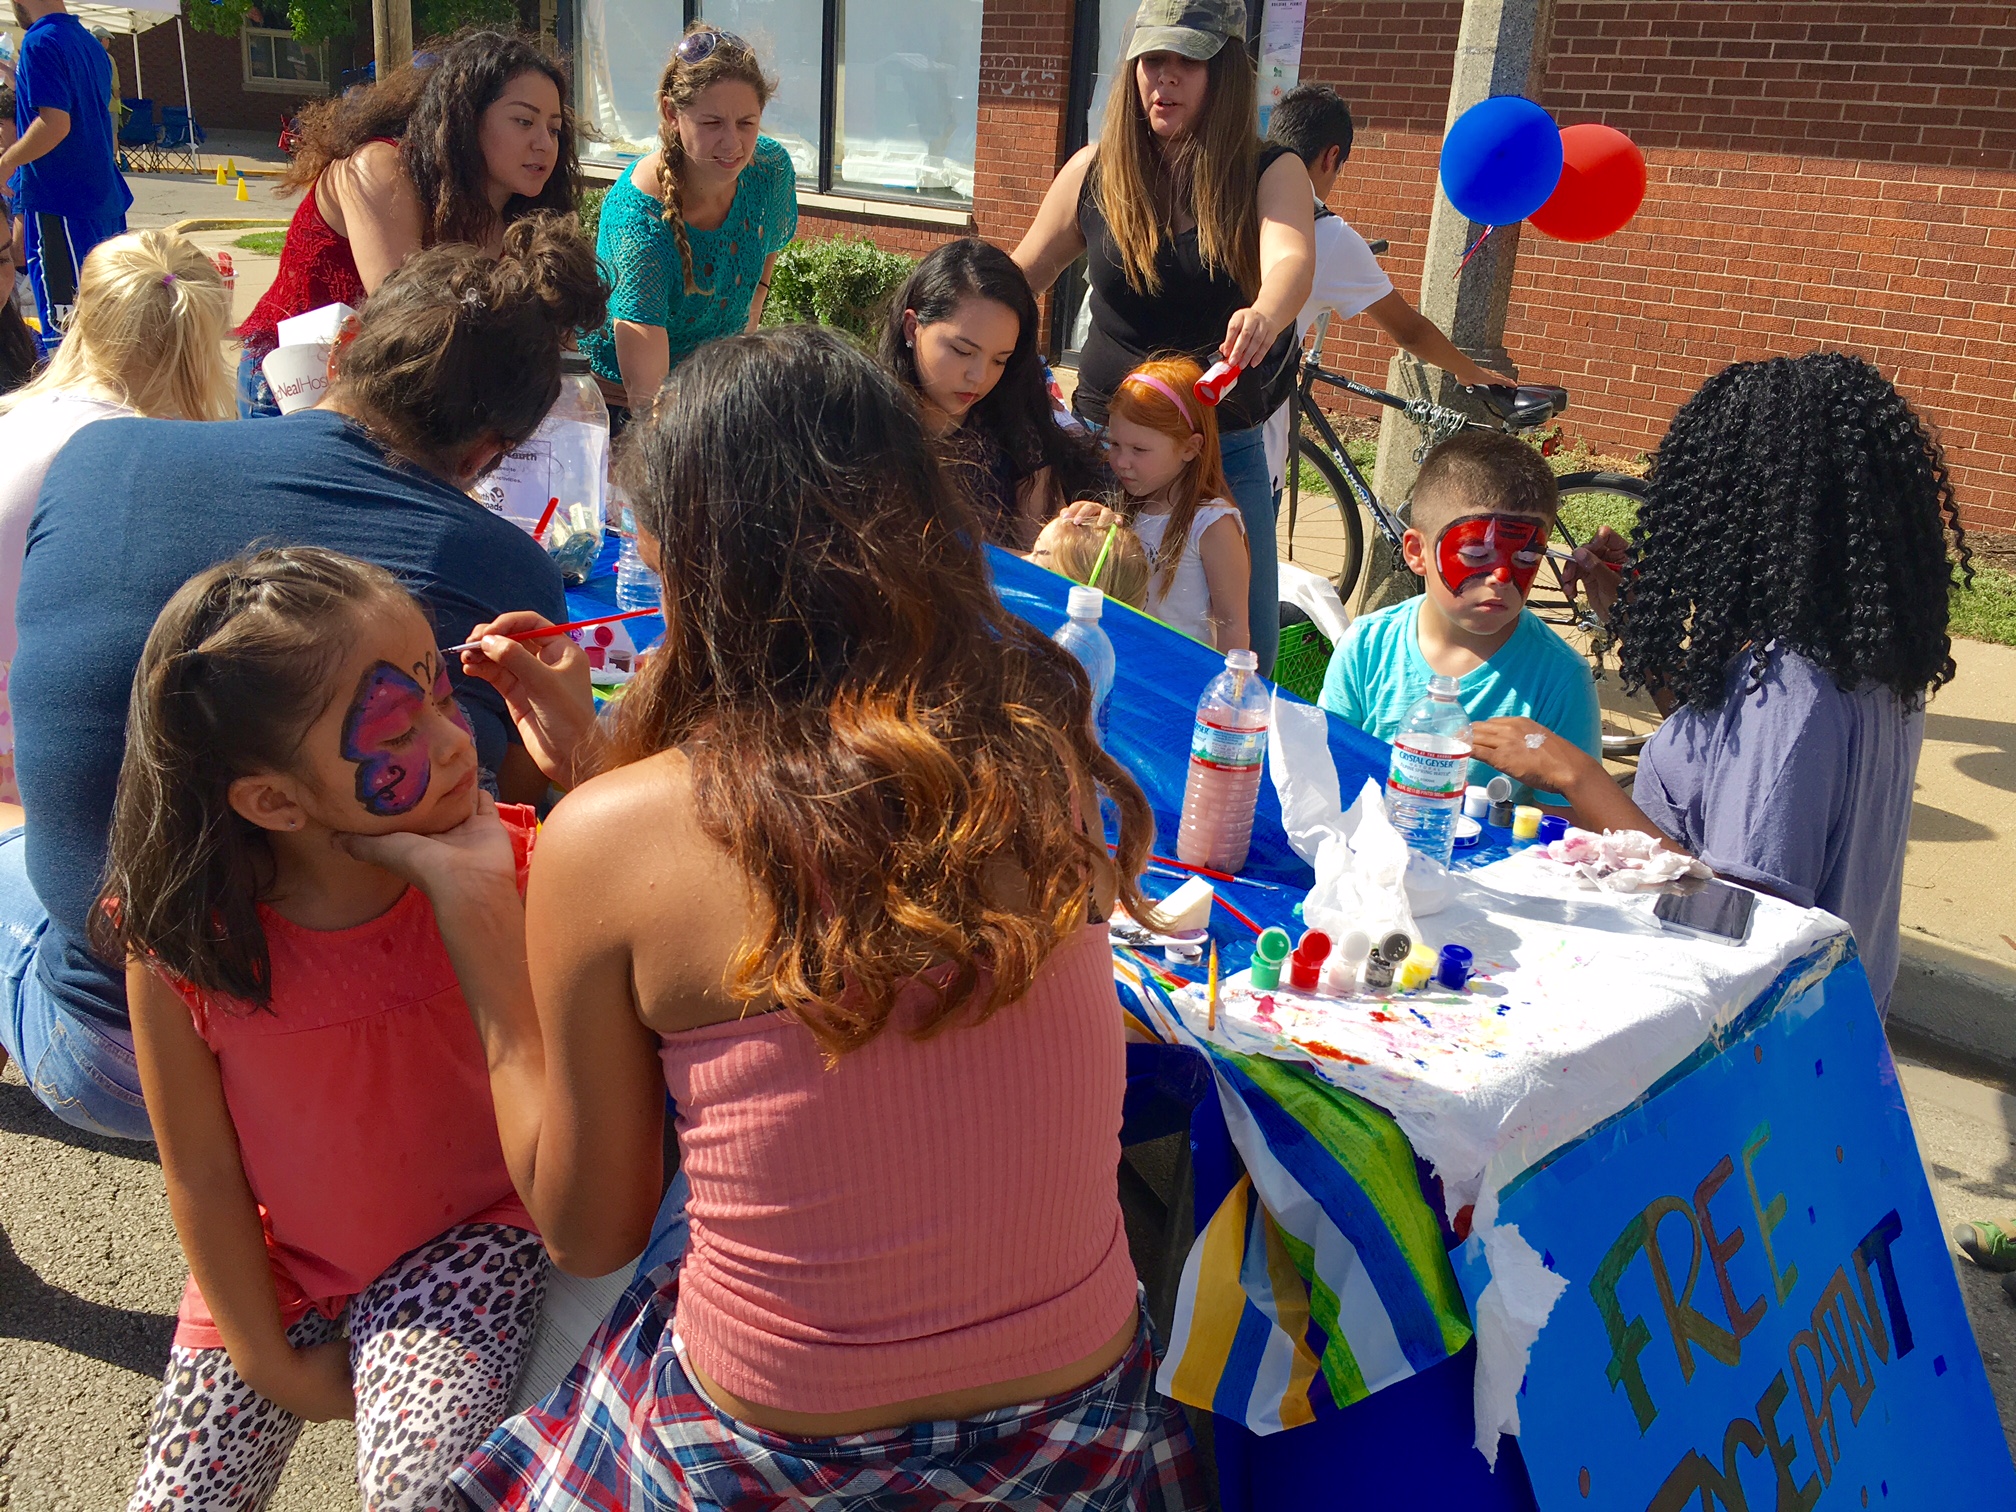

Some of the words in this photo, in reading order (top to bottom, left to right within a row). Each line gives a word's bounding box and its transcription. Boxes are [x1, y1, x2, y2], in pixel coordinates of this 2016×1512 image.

[1332, 448, 1395, 542] DIAMONDBACK
[1399, 751, 1424, 765] CRYSTAL
[1425, 758, 1453, 768] GEYSER
[1588, 1118, 1798, 1440] FREE
